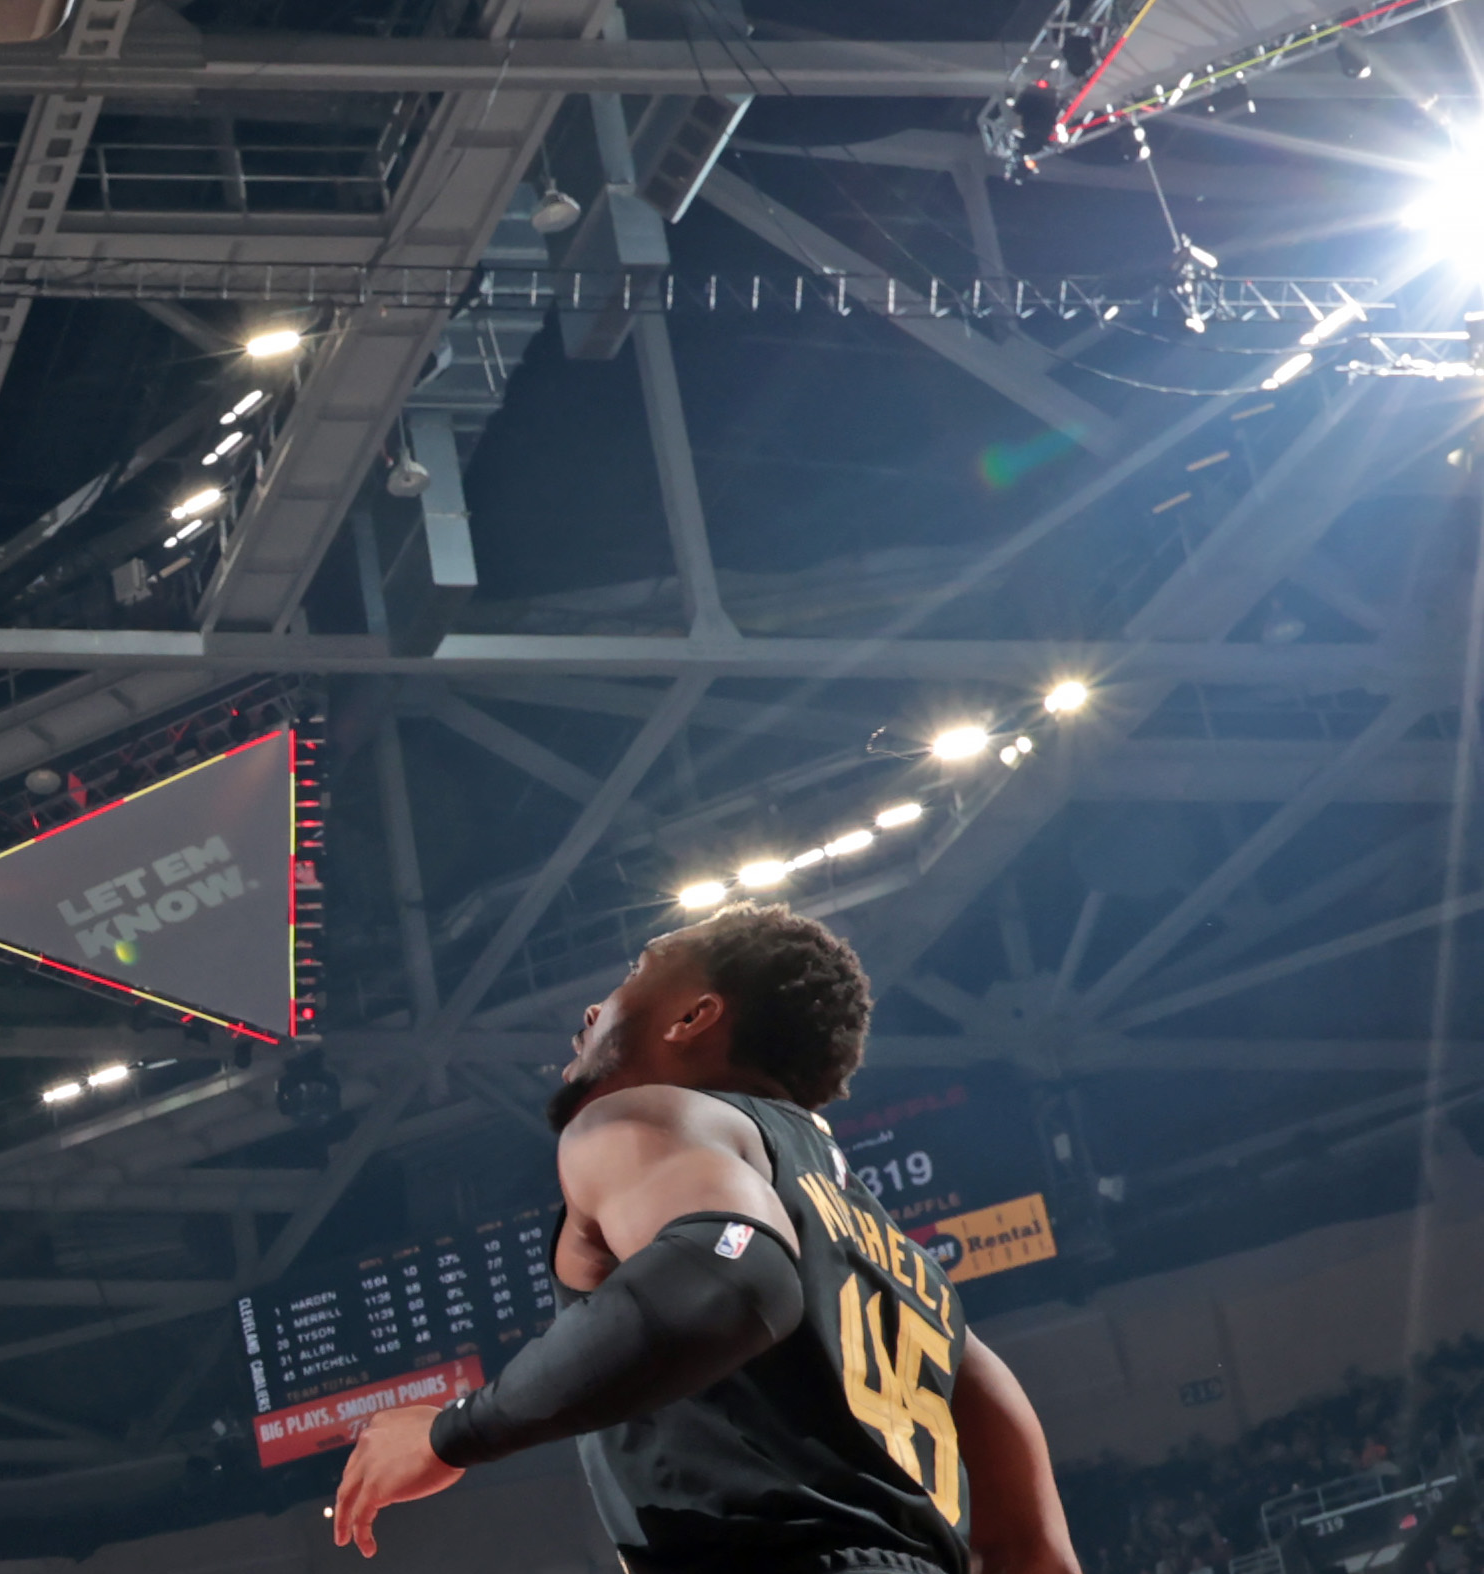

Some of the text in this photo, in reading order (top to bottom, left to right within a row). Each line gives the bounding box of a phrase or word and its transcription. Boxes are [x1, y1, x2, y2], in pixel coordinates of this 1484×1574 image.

[57, 835, 231, 927] LET EM
[74, 864, 260, 960] KNOW.
[966, 1217, 1044, 1255] Rental
[289, 1290, 337, 1312] HARDEN
[292, 1306, 342, 1328] MERRILL
[296, 1324, 336, 1344] TYSON
[298, 1341, 335, 1360] ALLEN
[301, 1351, 359, 1376] MITCHELL
[259, 1419, 285, 1442] BIG
[336, 1394, 397, 1422] SMOOTH
[399, 1373, 448, 1404] POURS
[839, 1272, 961, 1528] 45
